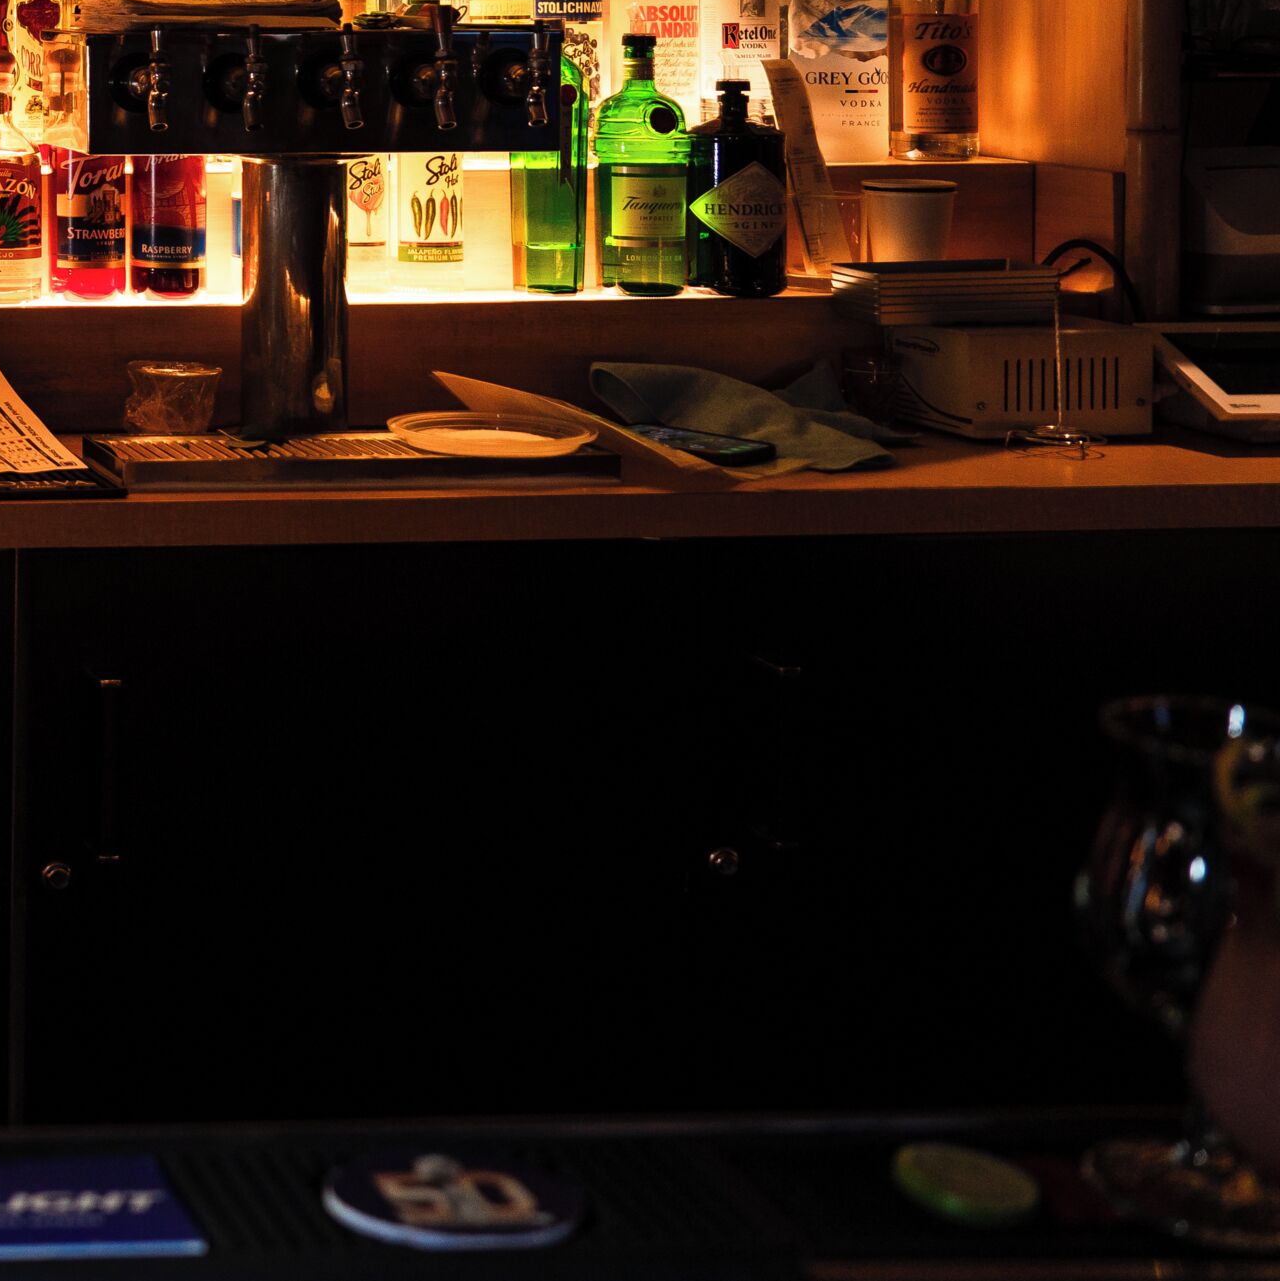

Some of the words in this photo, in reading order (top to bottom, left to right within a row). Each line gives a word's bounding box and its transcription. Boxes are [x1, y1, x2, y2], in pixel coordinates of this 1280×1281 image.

[722, 22, 758, 49] Ketel
[759, 25, 777, 41] One
[916, 19, 973, 41] Tito's
[740, 42, 768, 50] VODKA
[805, 71, 854, 86] GREY
[839, 99, 883, 109] VODKA
[841, 119, 882, 127] FRANCE
[348, 157, 383, 191] Stoli
[425, 153, 458, 186] Stoli
[741, 221, 772, 229] GIN
[140, 243, 193, 255] RASPBERRY
